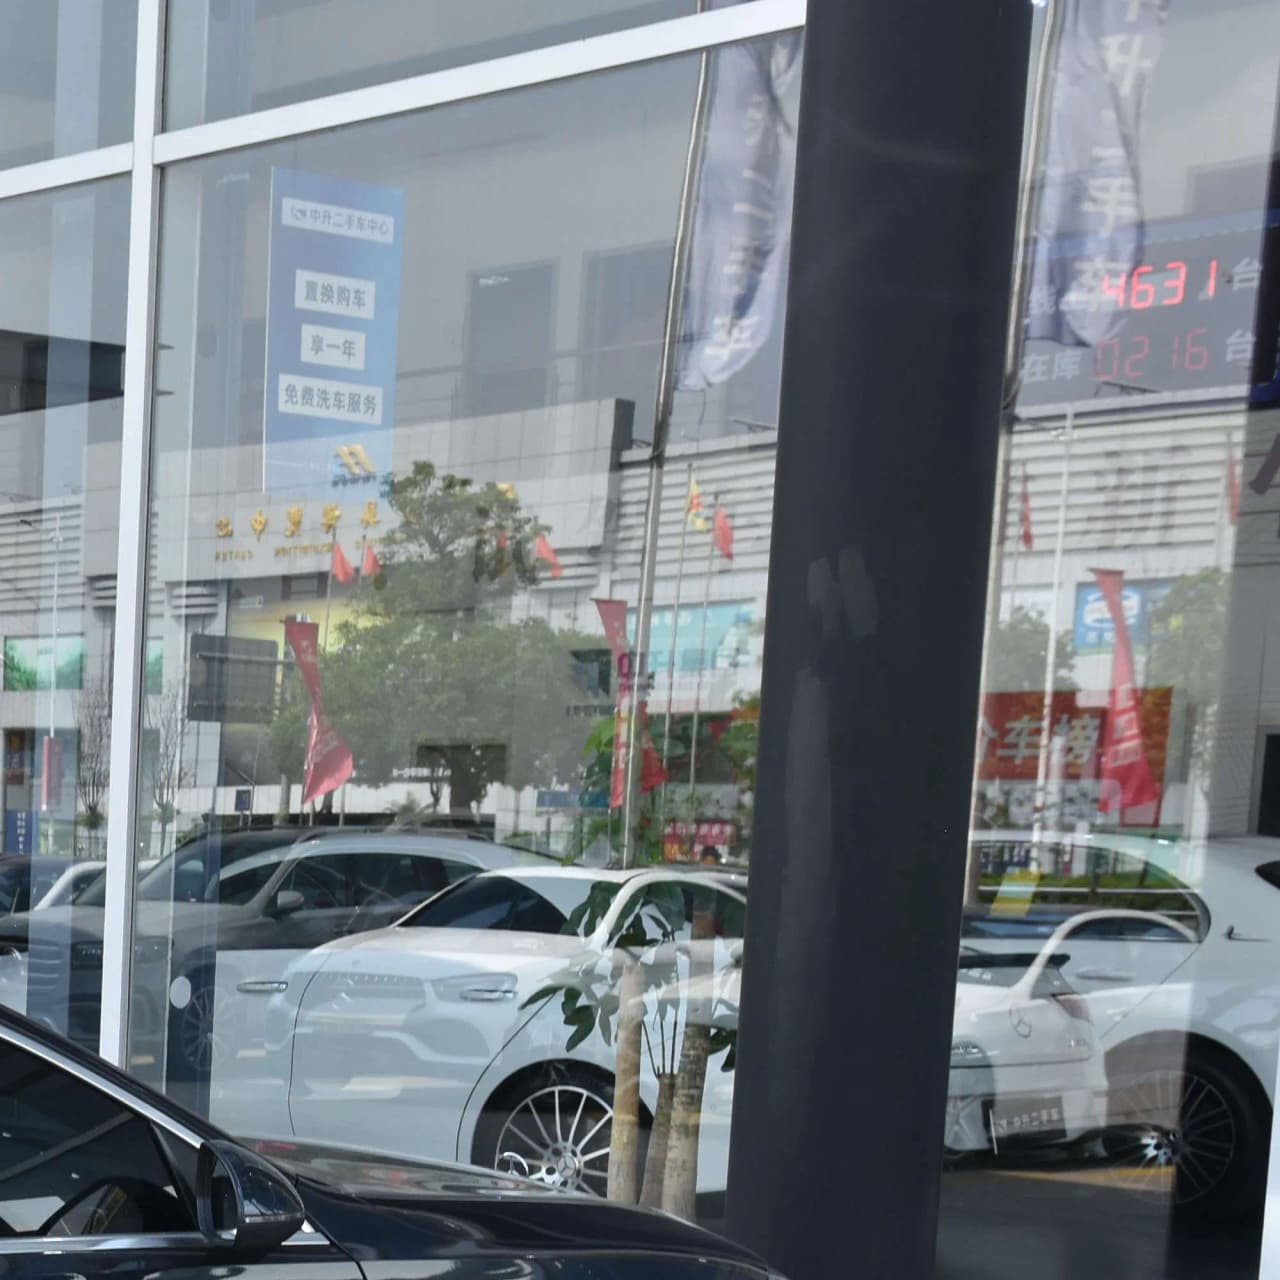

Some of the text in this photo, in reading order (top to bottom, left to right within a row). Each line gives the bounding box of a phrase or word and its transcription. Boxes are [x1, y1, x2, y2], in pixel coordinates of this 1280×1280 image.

[308, 206, 390, 237] 中升二手车中心
[303, 279, 367, 309] 置换购车
[310, 333, 358, 362] 享一年
[1019, 351, 1082, 385] 在库
[284, 384, 378, 416] 免费洗车服务
